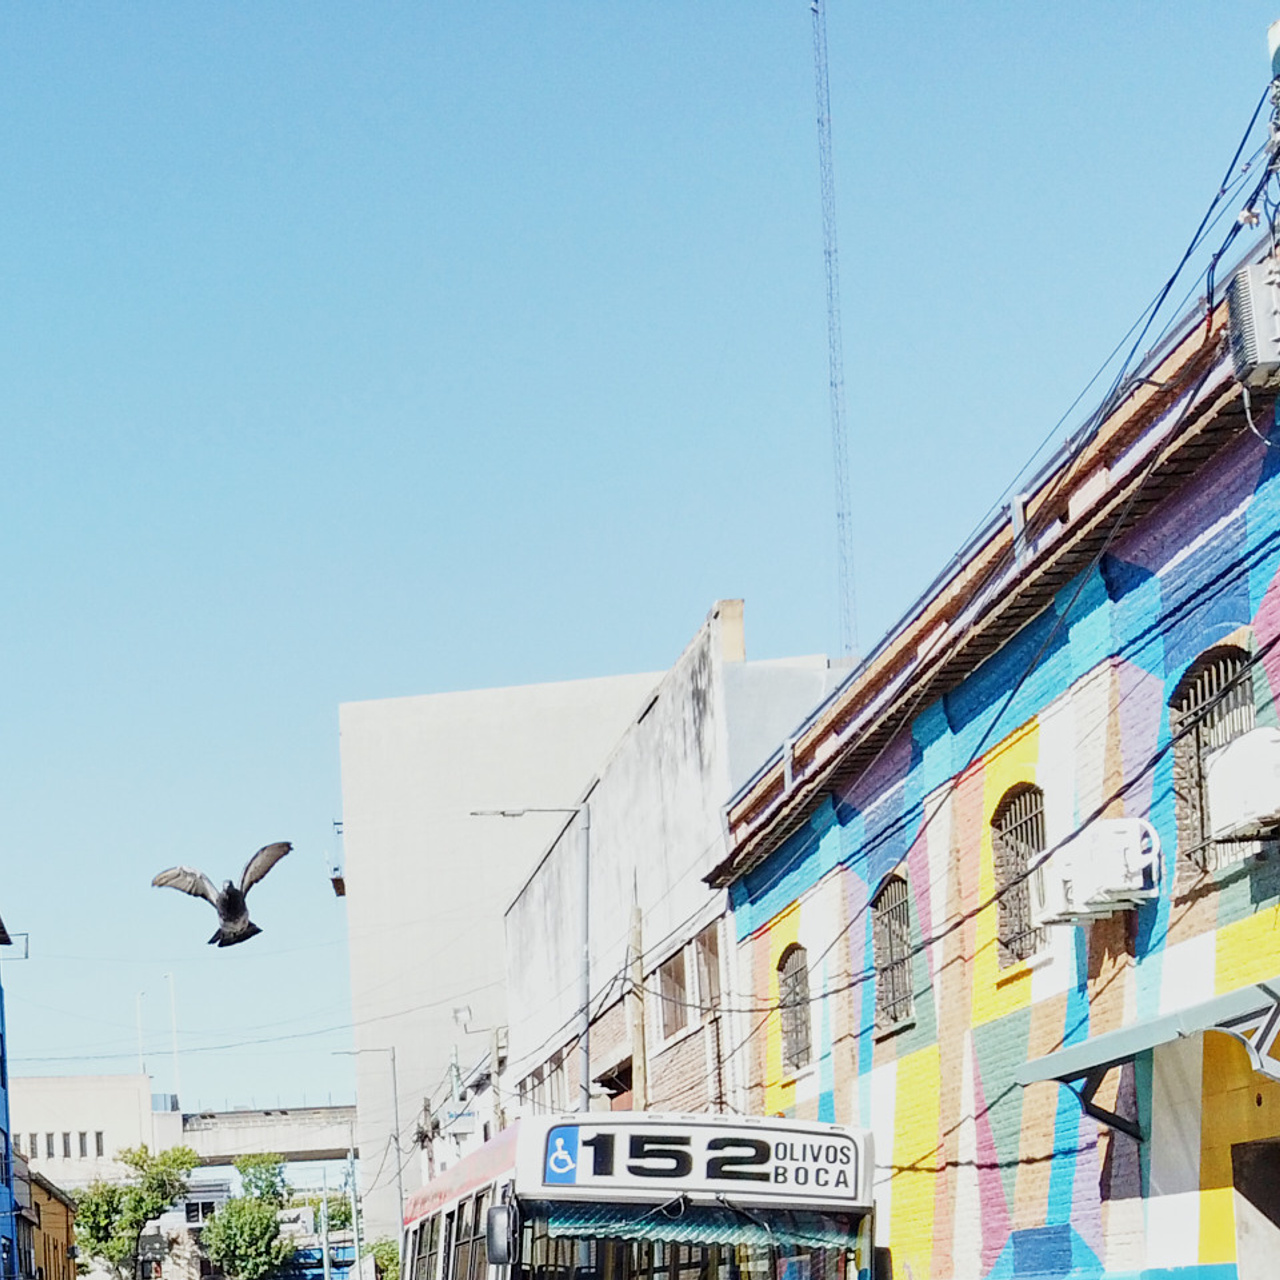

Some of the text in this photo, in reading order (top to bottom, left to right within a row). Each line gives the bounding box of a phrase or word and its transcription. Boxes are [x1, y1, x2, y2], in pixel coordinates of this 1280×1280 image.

[581, 1133, 771, 1183] 152
[774, 1142, 851, 1164] OLIVOS
[773, 1166, 849, 1188] BOCA
